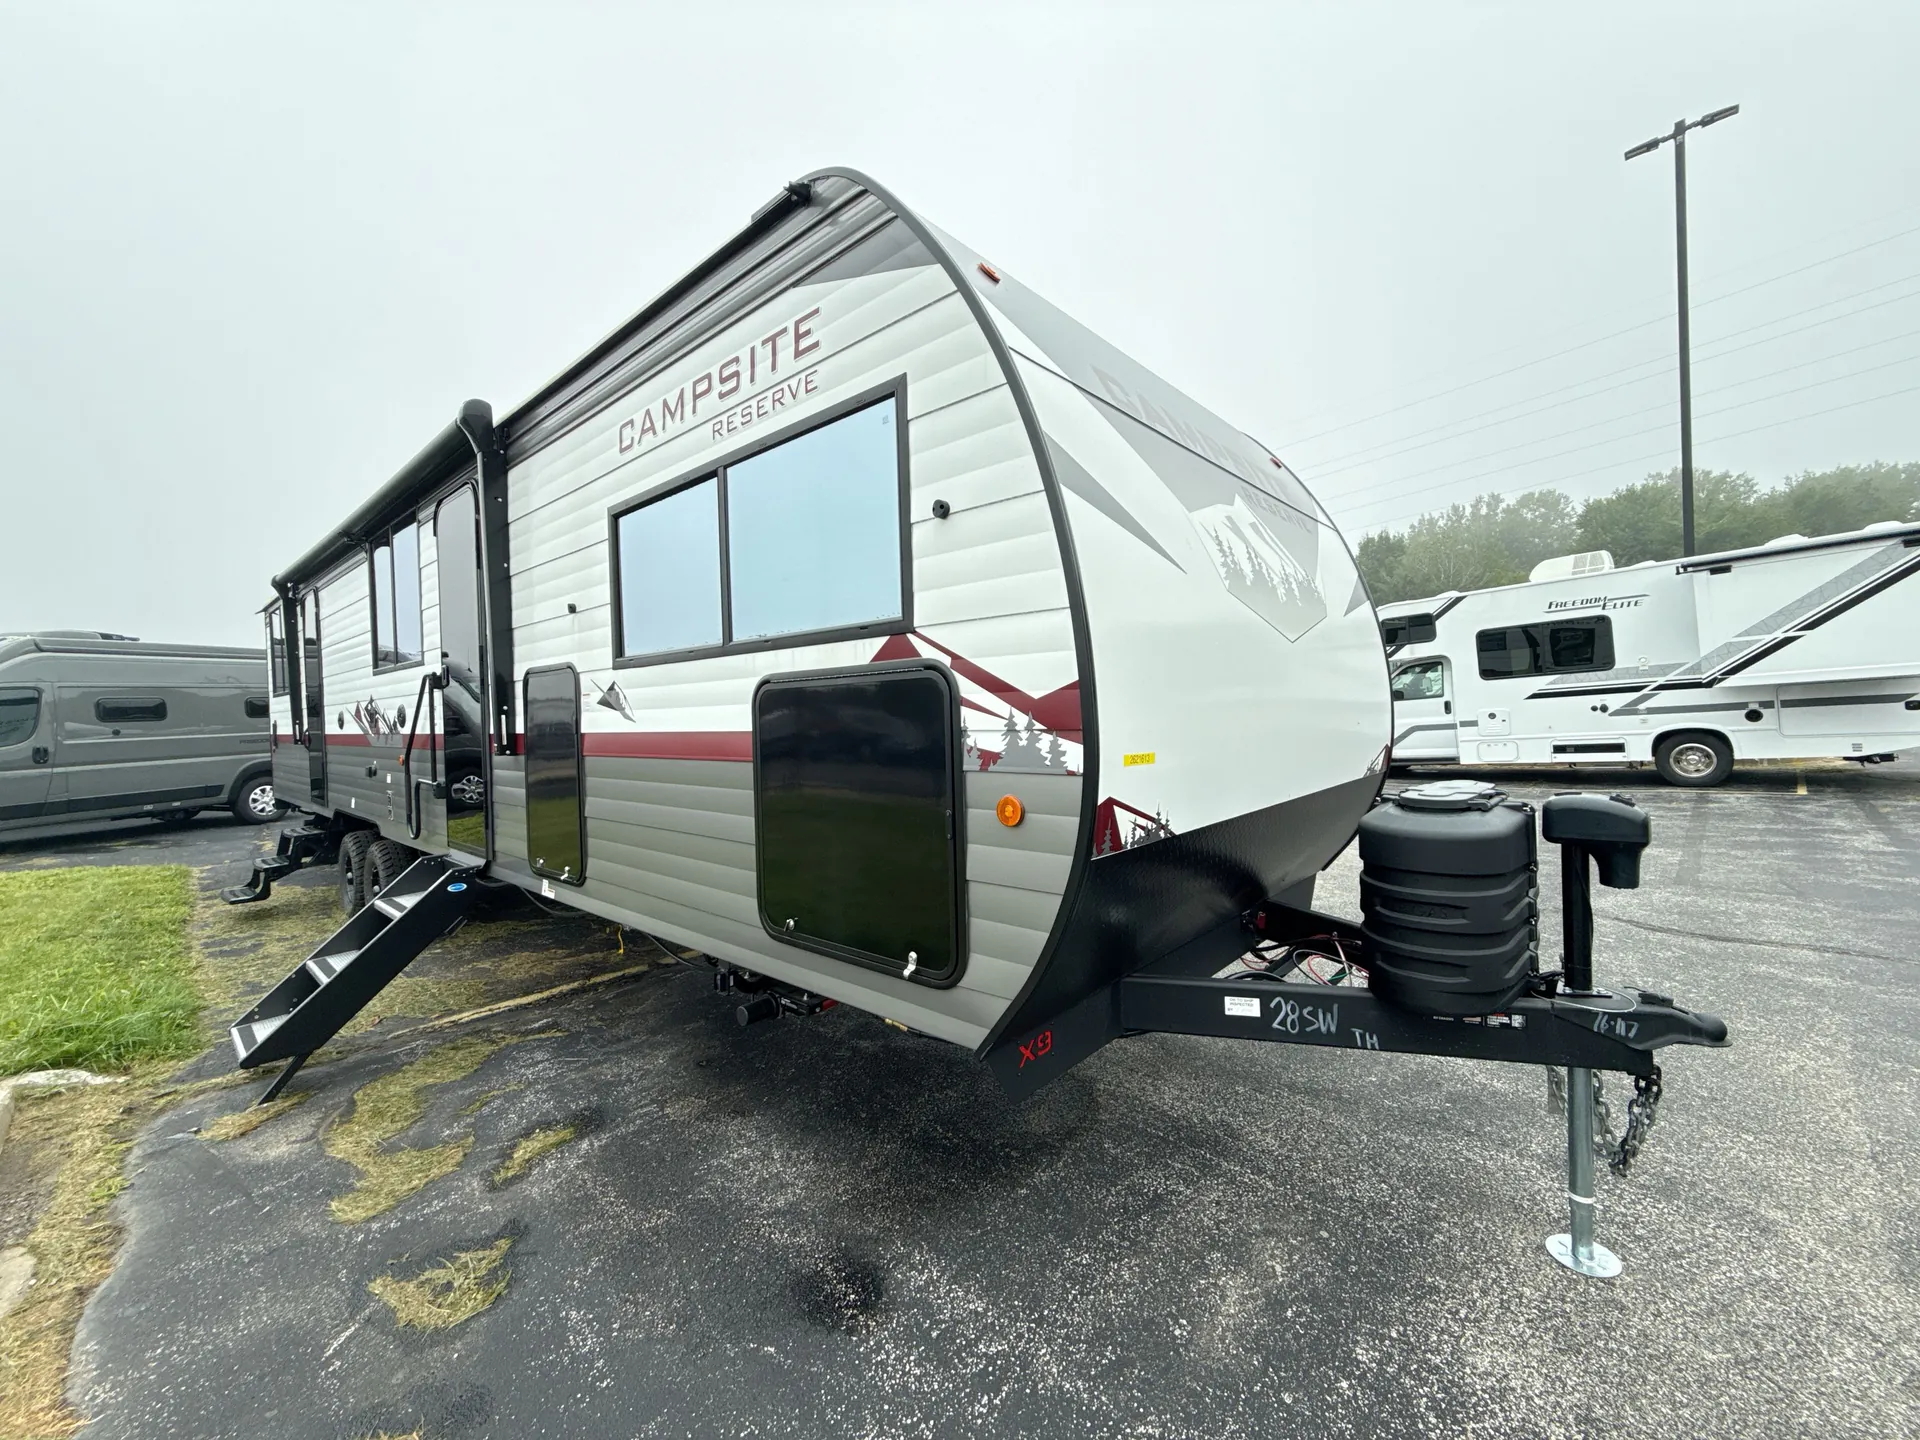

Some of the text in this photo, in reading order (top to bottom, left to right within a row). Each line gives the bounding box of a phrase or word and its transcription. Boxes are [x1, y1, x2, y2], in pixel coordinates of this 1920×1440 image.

[618, 306, 821, 455] CAMPSITE
[711, 369, 819, 442] RESERVE
[1547, 595, 1645, 611] FREEDOM ELITE
[1350, 1027, 1380, 1050] TH
